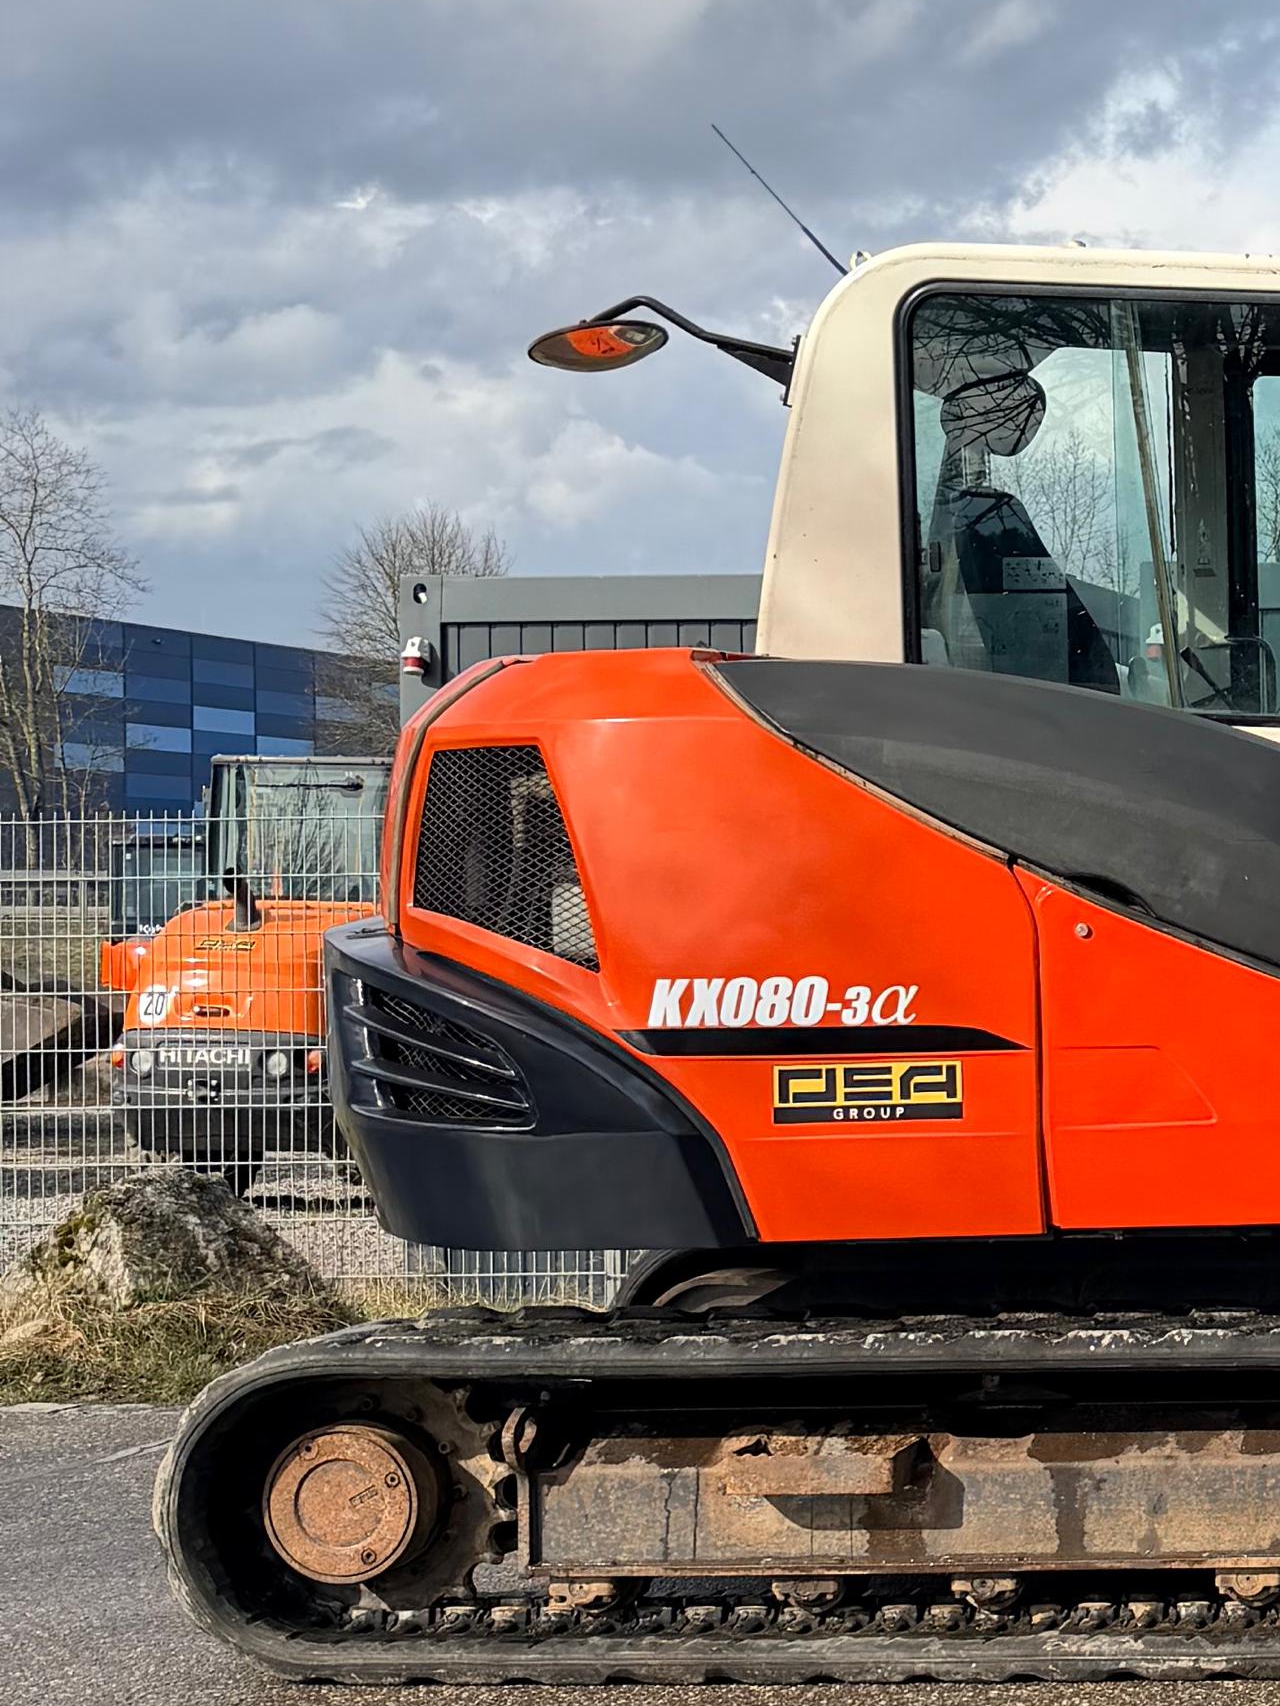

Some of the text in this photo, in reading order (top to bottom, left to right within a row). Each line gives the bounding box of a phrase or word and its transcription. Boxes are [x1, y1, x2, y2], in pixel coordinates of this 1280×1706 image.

[143, 992, 166, 1016] 20
[158, 1047, 251, 1065] HITACHI
[833, 1107, 905, 1120] GROUP
